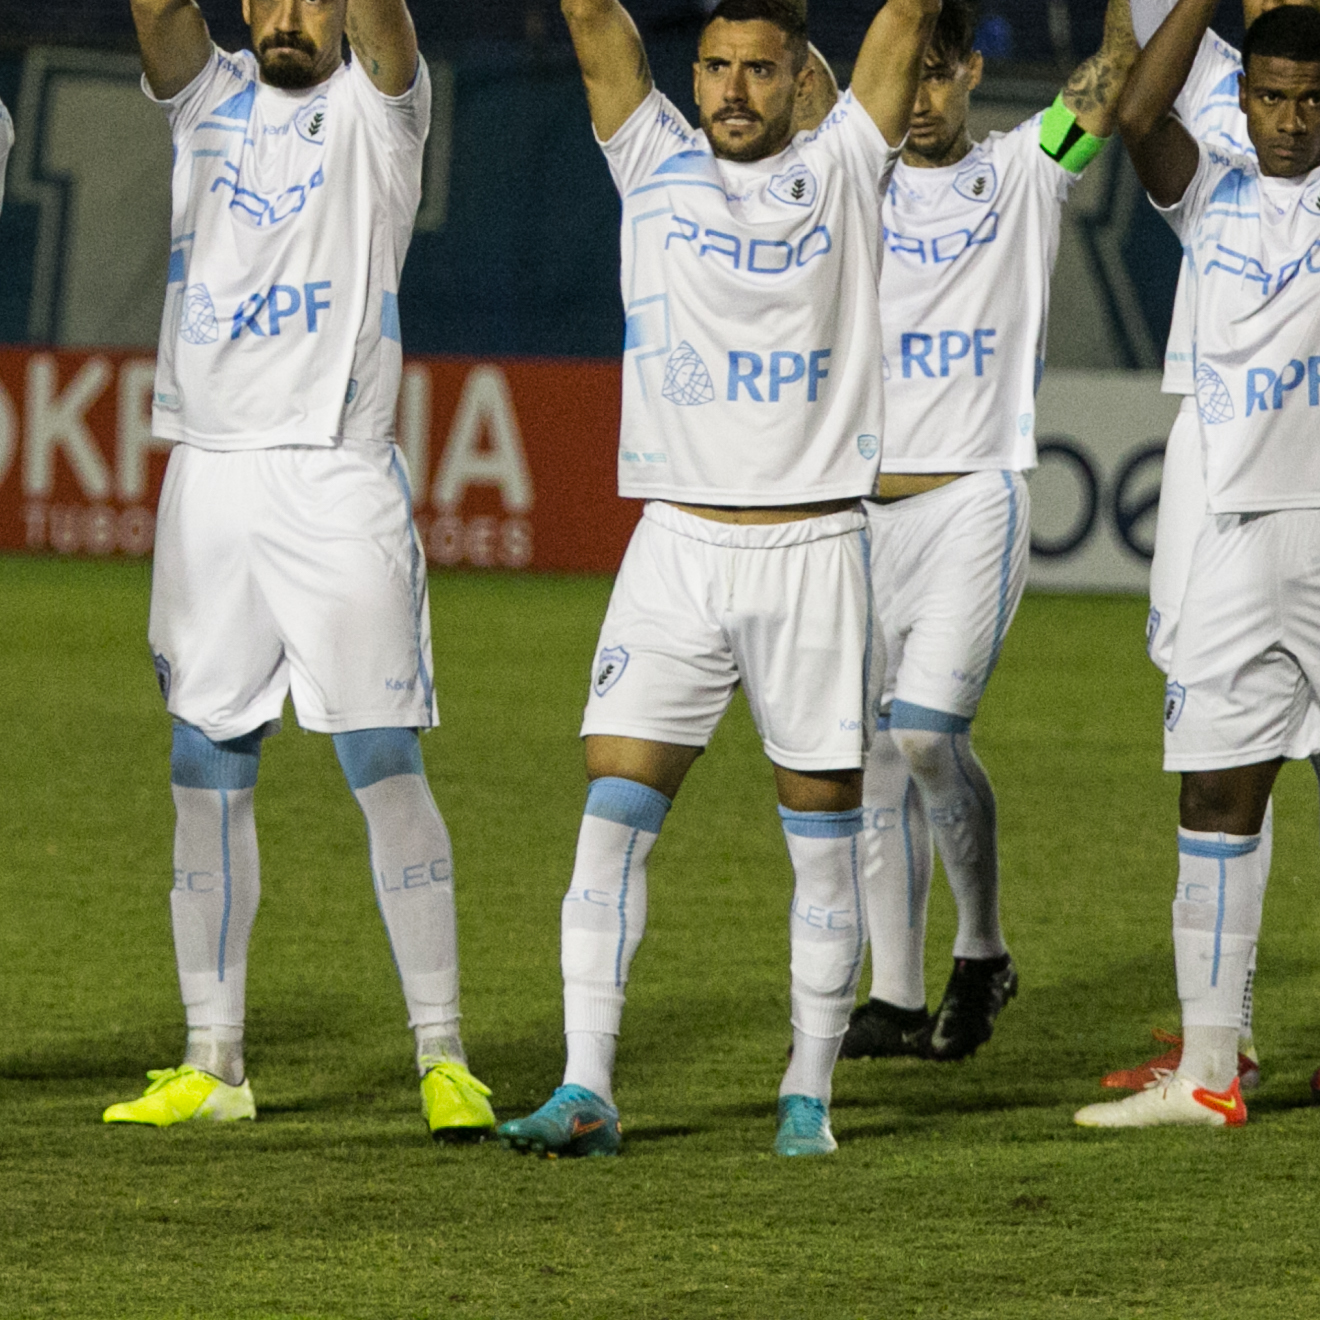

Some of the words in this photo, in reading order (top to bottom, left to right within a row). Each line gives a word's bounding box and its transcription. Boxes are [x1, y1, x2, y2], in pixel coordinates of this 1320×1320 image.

[664, 214, 831, 274] PADO
[883, 211, 998, 265] ADO
[231, 280, 332, 341] RPF
[726, 348, 832, 402] RPF
[900, 328, 997, 379] RPF
[380, 857, 448, 894] LEC
